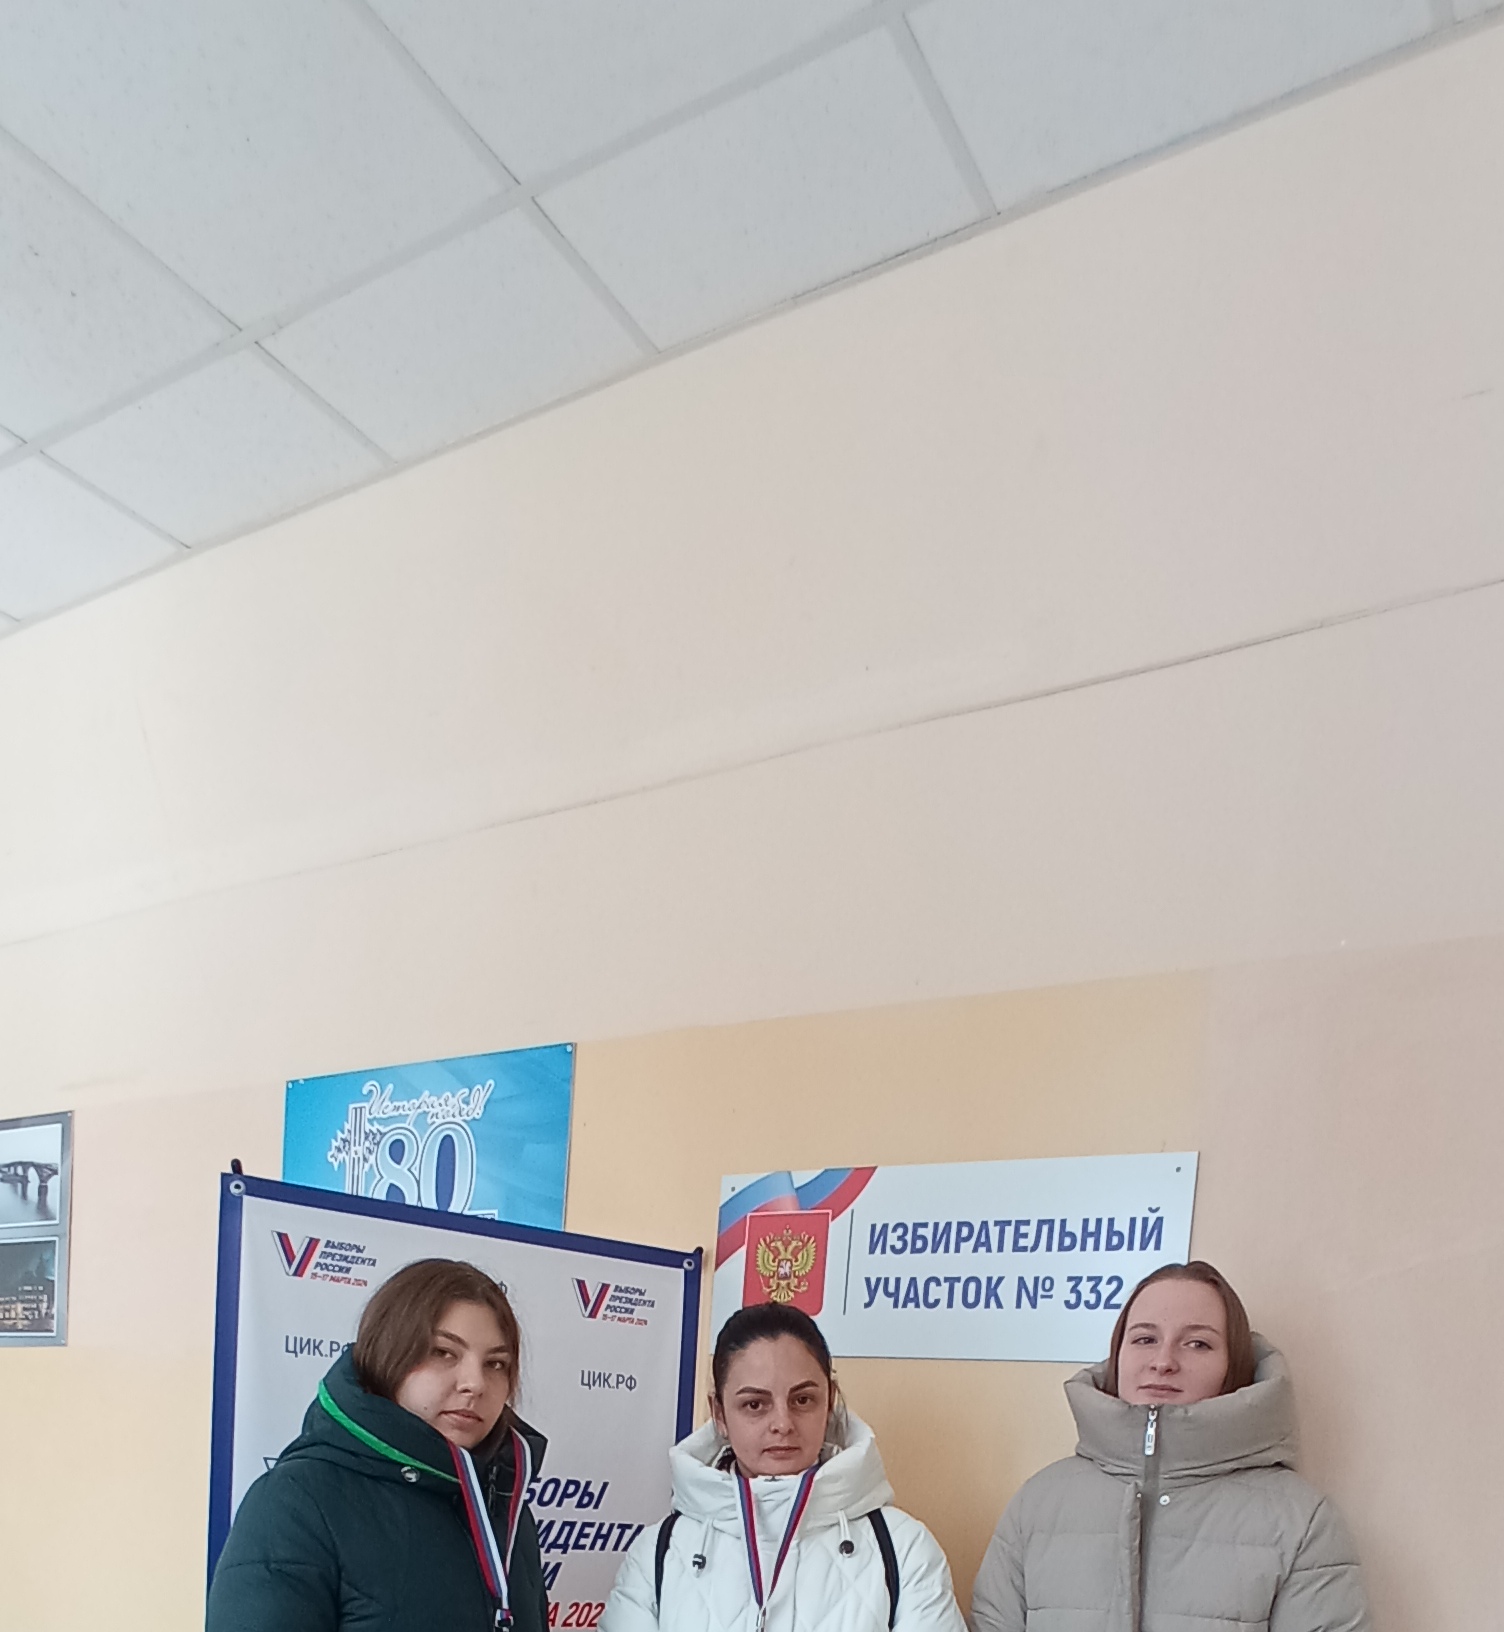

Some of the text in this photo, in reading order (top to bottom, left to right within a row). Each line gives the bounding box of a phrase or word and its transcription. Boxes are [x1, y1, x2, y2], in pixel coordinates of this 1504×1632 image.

[371, 1125, 476, 1214] 80
[868, 1206, 1164, 1255] ИЗБИРАТЕЛЬНЫЙ
[323, 1239, 366, 1254] ВЫБОРЫ
[319, 1250, 377, 1267] ПРЕЗИДЕНТА
[314, 1261, 352, 1275] РОССИИ
[613, 1284, 647, 1297] ВЫБОРЫ
[863, 1275, 1124, 1311] УЧАСТОК № 332
[604, 1304, 635, 1316] РОССИИ
[608, 1294, 656, 1309] ПРЕЗИДЕНТА
[580, 1369, 637, 1392] ЦИК.РФ
[561, 1602, 606, 1628] 202
